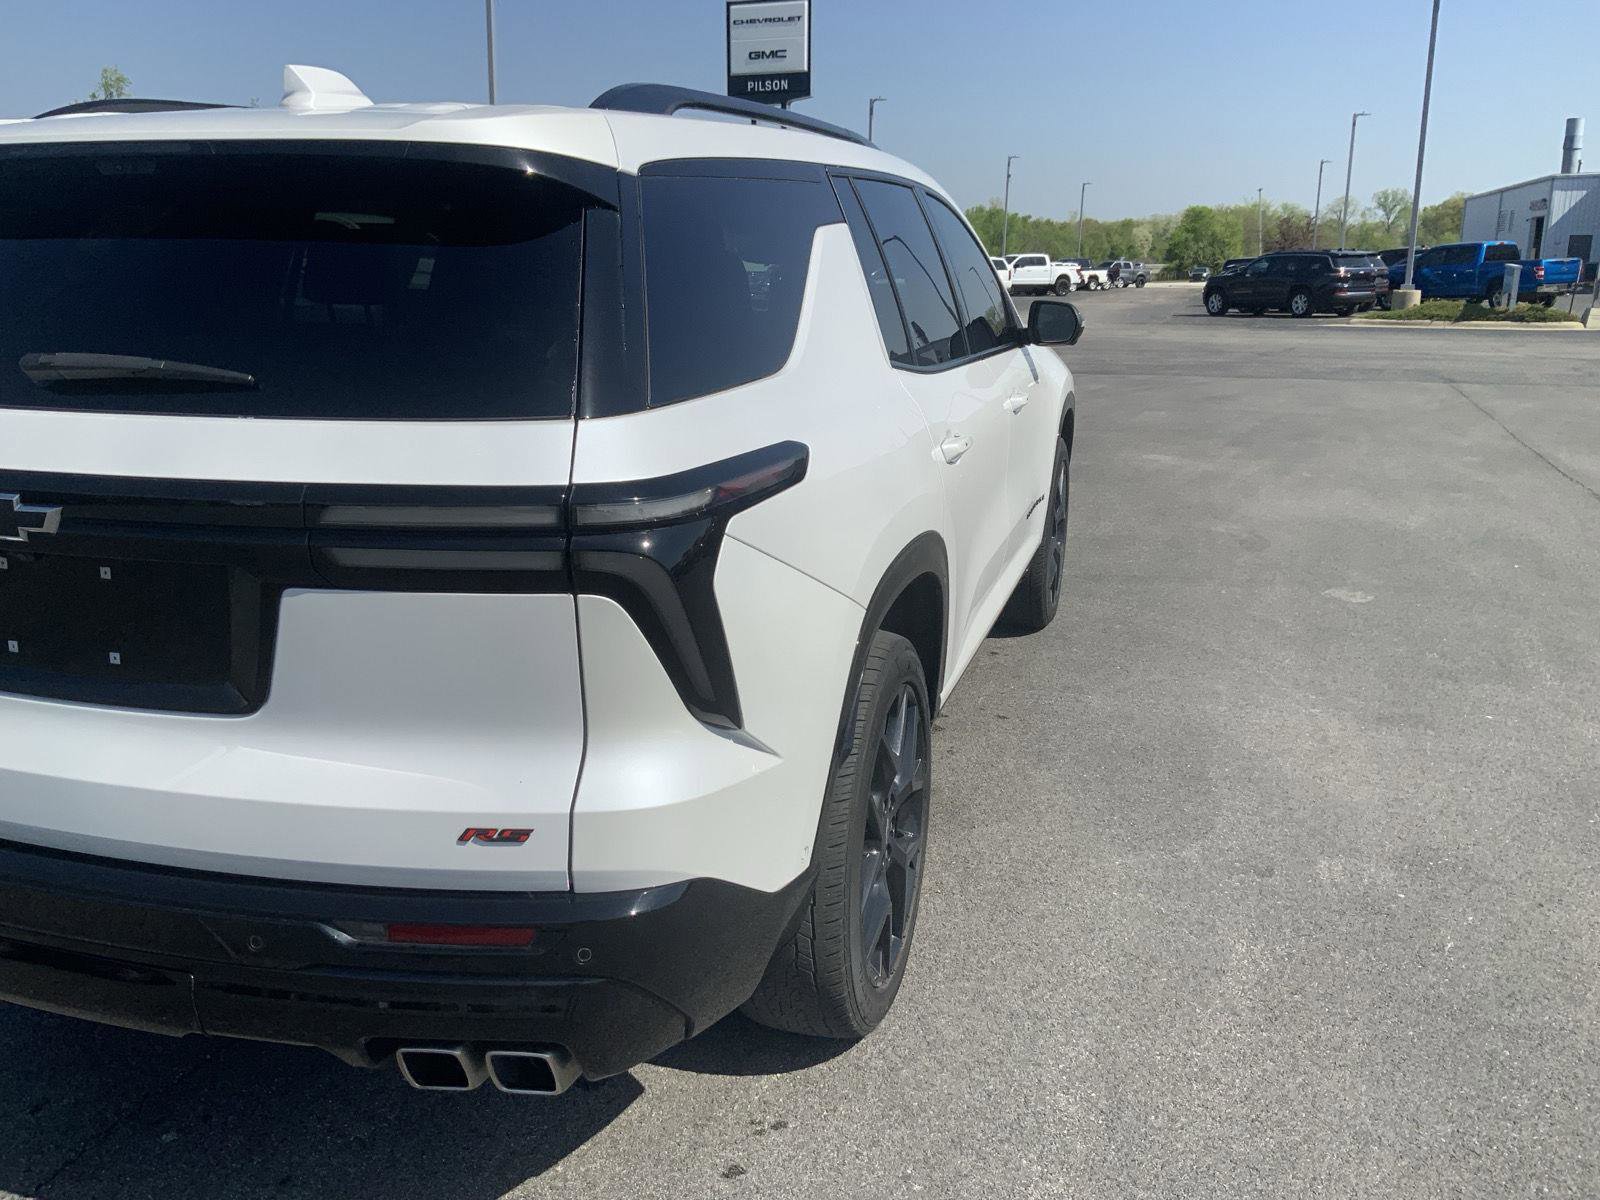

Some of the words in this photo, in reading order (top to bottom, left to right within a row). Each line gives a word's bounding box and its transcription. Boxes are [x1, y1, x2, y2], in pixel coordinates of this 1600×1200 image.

[733, 15, 802, 26] CHEVROLET
[748, 49, 787, 60] GMC
[747, 79, 788, 92] PILSON
[456, 827, 535, 844] RS
